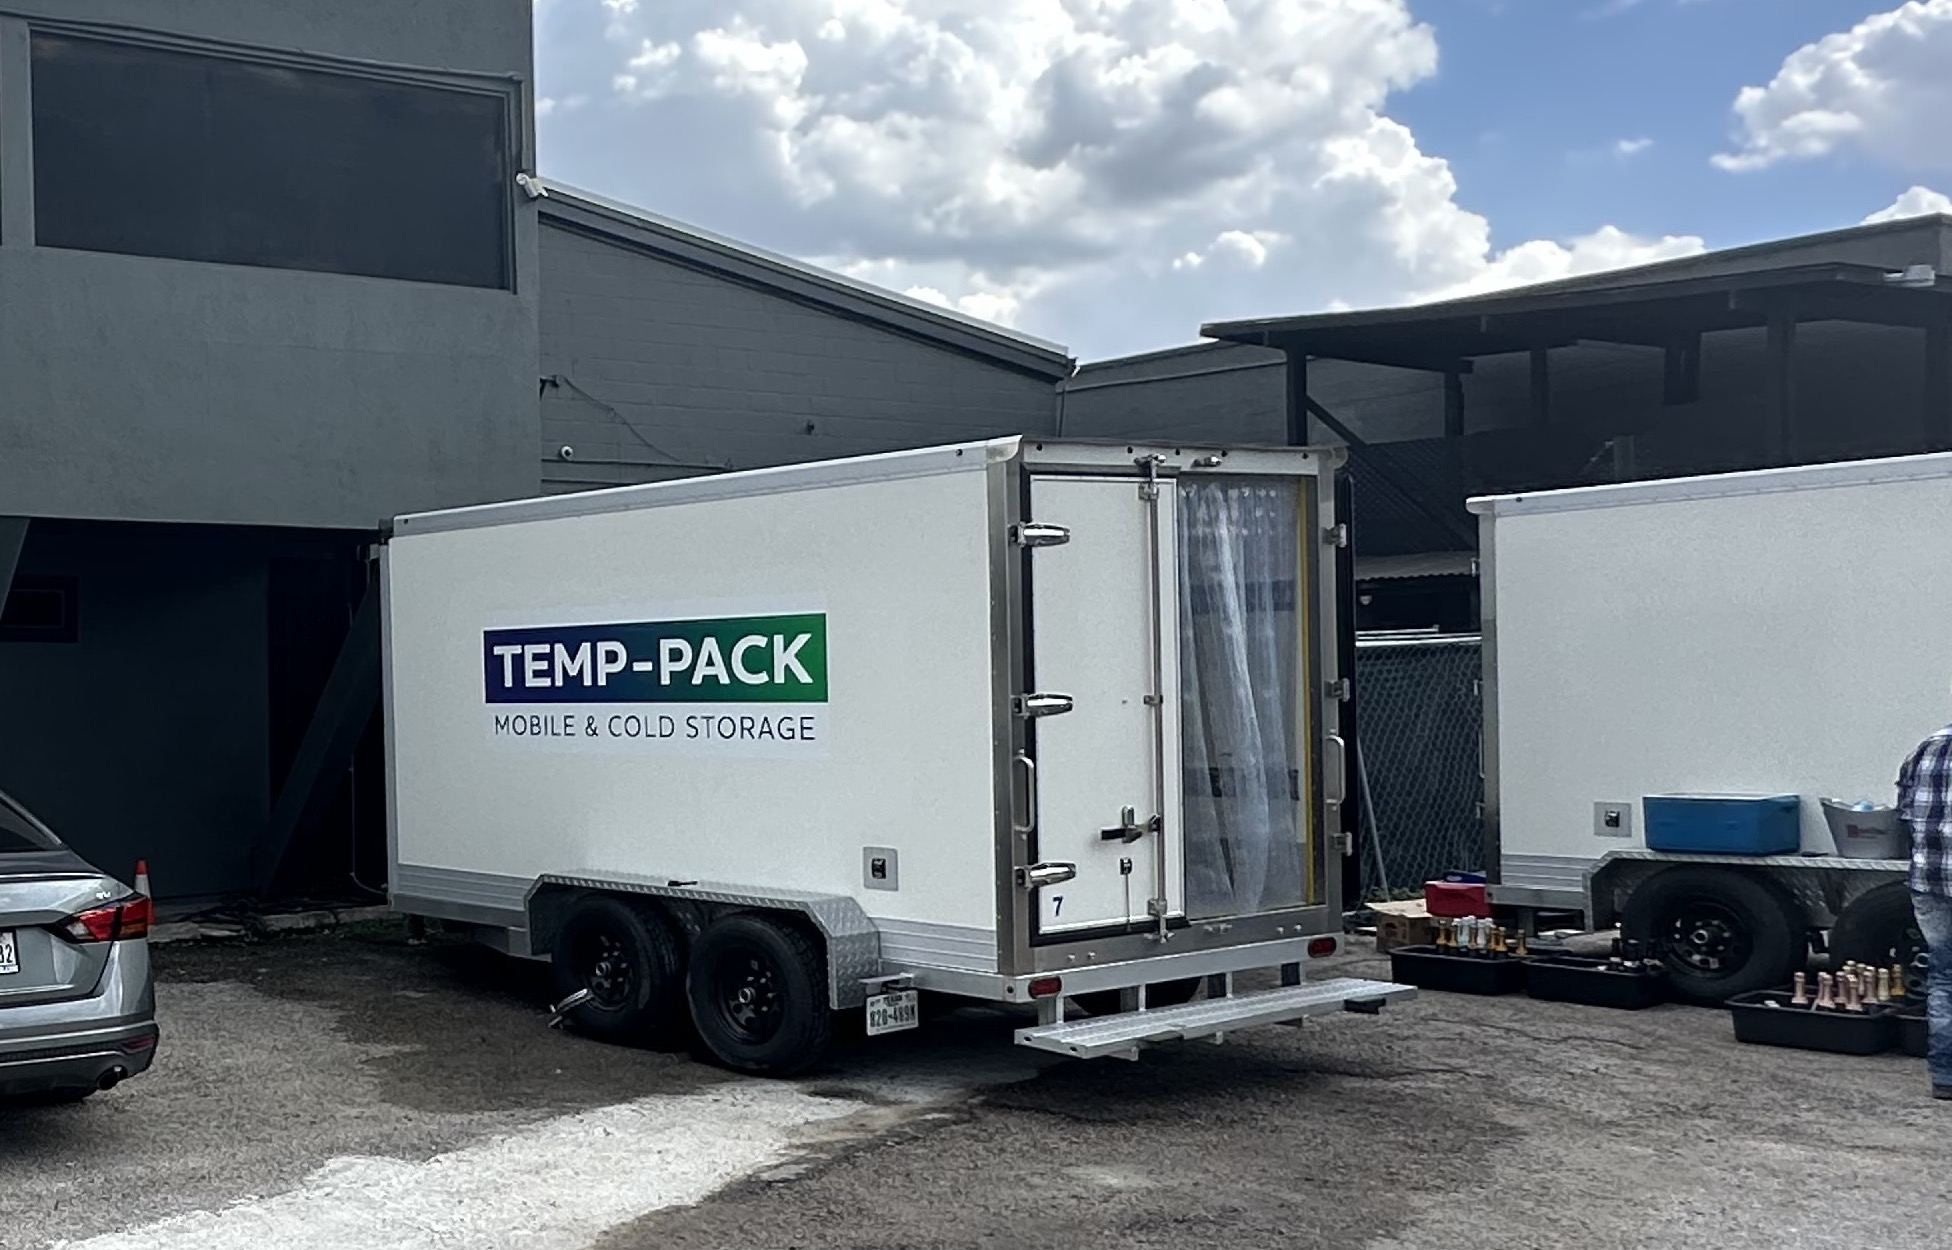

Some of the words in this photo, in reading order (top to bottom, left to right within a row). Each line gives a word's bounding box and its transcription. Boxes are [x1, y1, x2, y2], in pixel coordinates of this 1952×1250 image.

[493, 633, 814, 688] TEMP-PACK
[494, 714, 576, 738] MOBILE
[584, 715, 599, 738] &
[608, 715, 676, 739] COLD
[686, 716, 816, 741] STORAGE
[1053, 896, 1063, 917] 7
